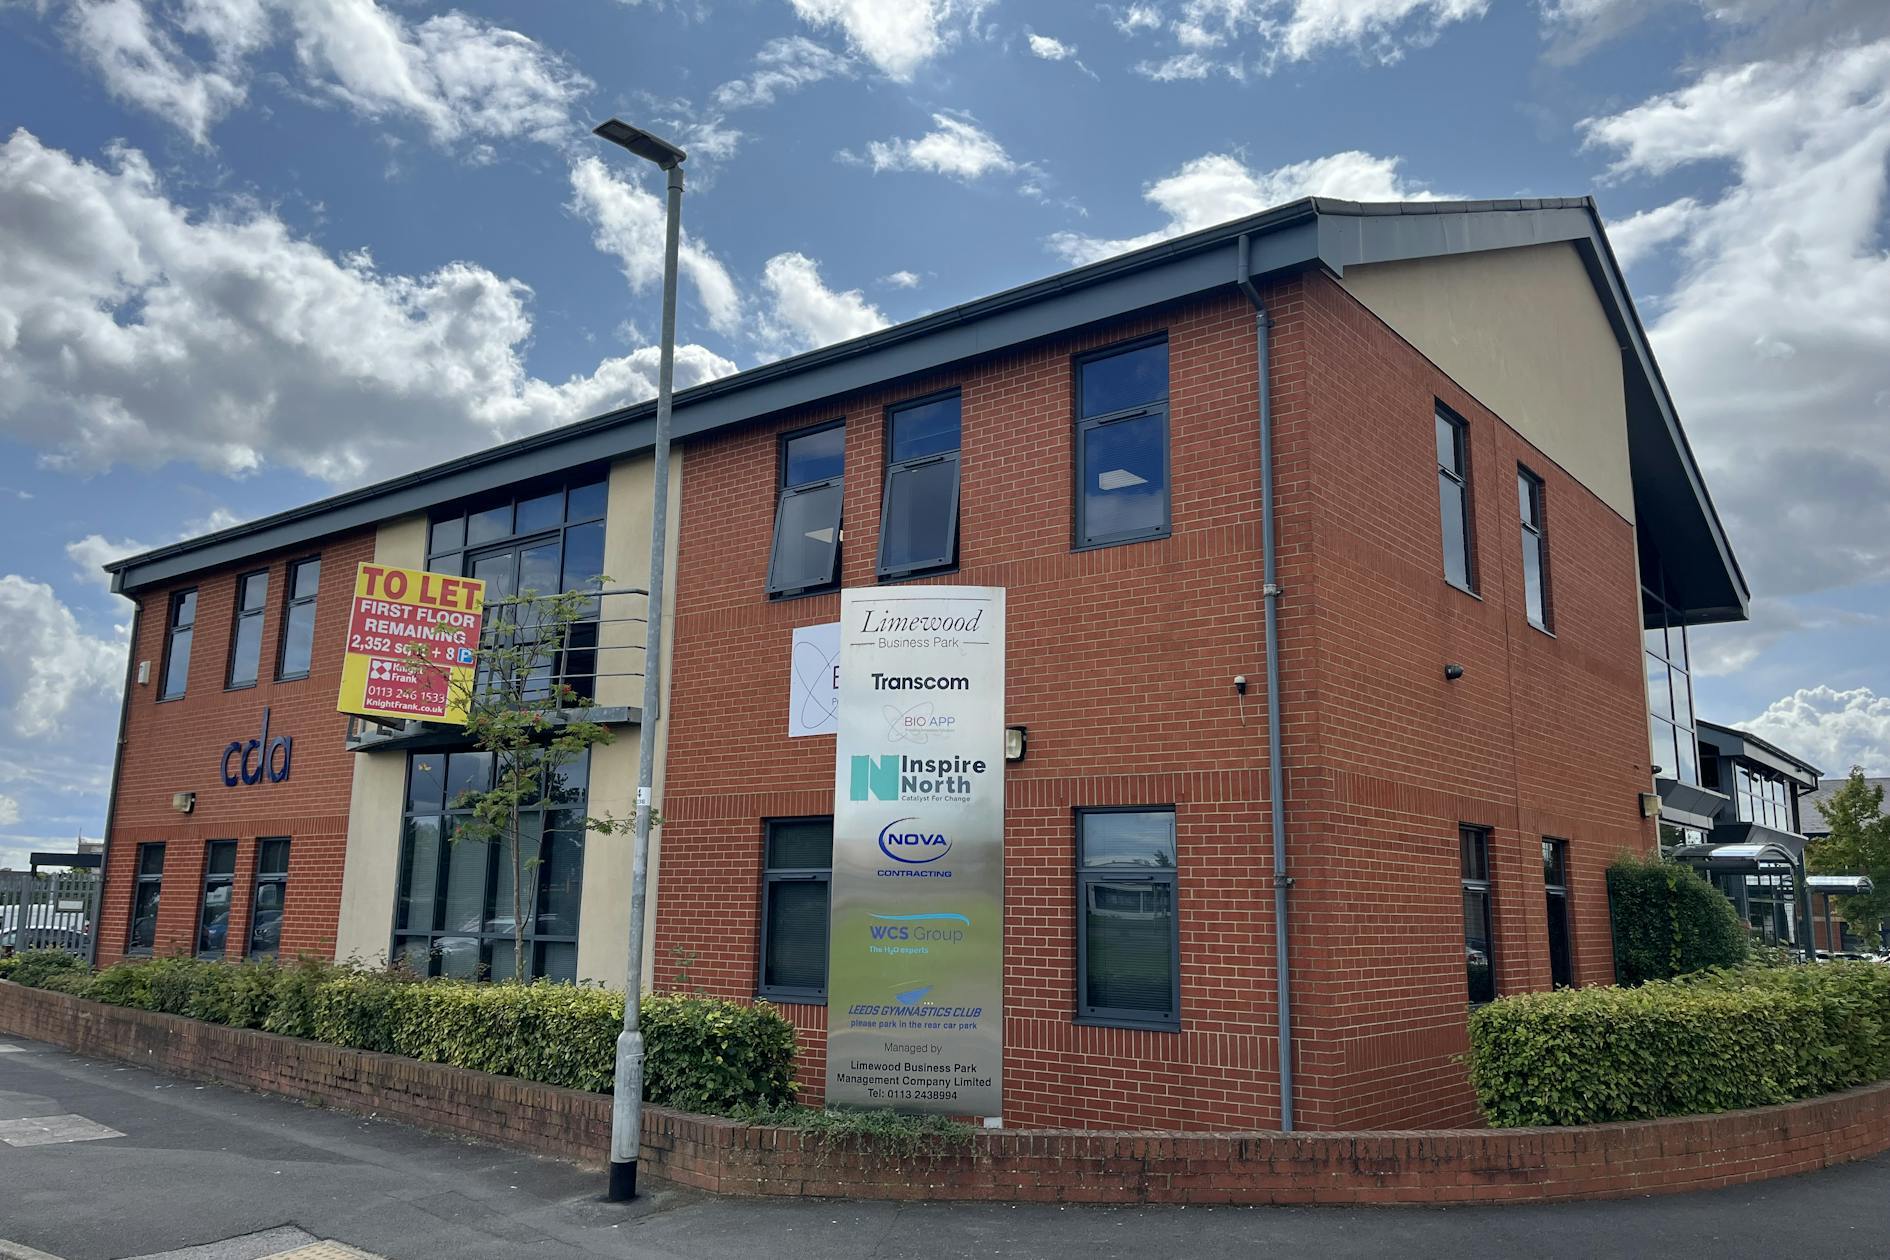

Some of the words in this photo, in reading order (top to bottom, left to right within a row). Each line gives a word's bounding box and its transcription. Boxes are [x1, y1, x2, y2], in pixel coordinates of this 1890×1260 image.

[363, 566, 408, 600] TO
[419, 575, 482, 611] LET
[360, 600, 413, 619] FIRST
[416, 607, 475, 628] FLOOR
[860, 608, 984, 634] Limewood
[364, 618, 467, 644] REMAINING
[351, 634, 391, 651] 2,352
[878, 637, 930, 649] Business
[933, 636, 960, 648] Park
[391, 672, 417, 684] Frank
[871, 672, 970, 691] Transcom
[368, 685, 393, 698] 0113
[396, 688, 418, 700] 246
[421, 691, 446, 704] 1533
[366, 698, 444, 714] KnightFrank.co.uk
[904, 716, 927, 727] BIO
[929, 716, 956, 727] APP
[221, 704, 293, 787] cda
[902, 755, 987, 778] Inspire
[902, 775, 971, 794] North
[901, 795, 930, 803] Catalyst
[944, 795, 971, 803] Change
[888, 833, 947, 846] NOVA
[877, 869, 952, 878] CONTRACTING
[870, 926, 909, 940] WCS
[913, 925, 964, 944] Group
[848, 1004, 880, 1016] LEEDS
[881, 1005, 952, 1017] GYMNASTICS
[953, 1006, 982, 1018] CLUB
[850, 1019, 877, 1029] please
[879, 1019, 897, 1029] park
[900, 1020, 907, 1028] in
[909, 1020, 923, 1029] the
[924, 1021, 941, 1029] rear
[943, 1022, 957, 1030] car
[959, 1021, 978, 1031] park
[884, 1042, 928, 1055] Managed
[930, 1043, 943, 1056] by
[850, 1060, 901, 1072] Limewood
[904, 1062, 951, 1073] Business
[954, 1063, 977, 1073] Park
[836, 1073, 900, 1086] Management
[902, 1076, 951, 1088] Company
[954, 1077, 992, 1087] Limited
[867, 1088, 885, 1098] Tel:
[887, 1089, 912, 1099] 0113
[914, 1090, 958, 1100] 2438994
